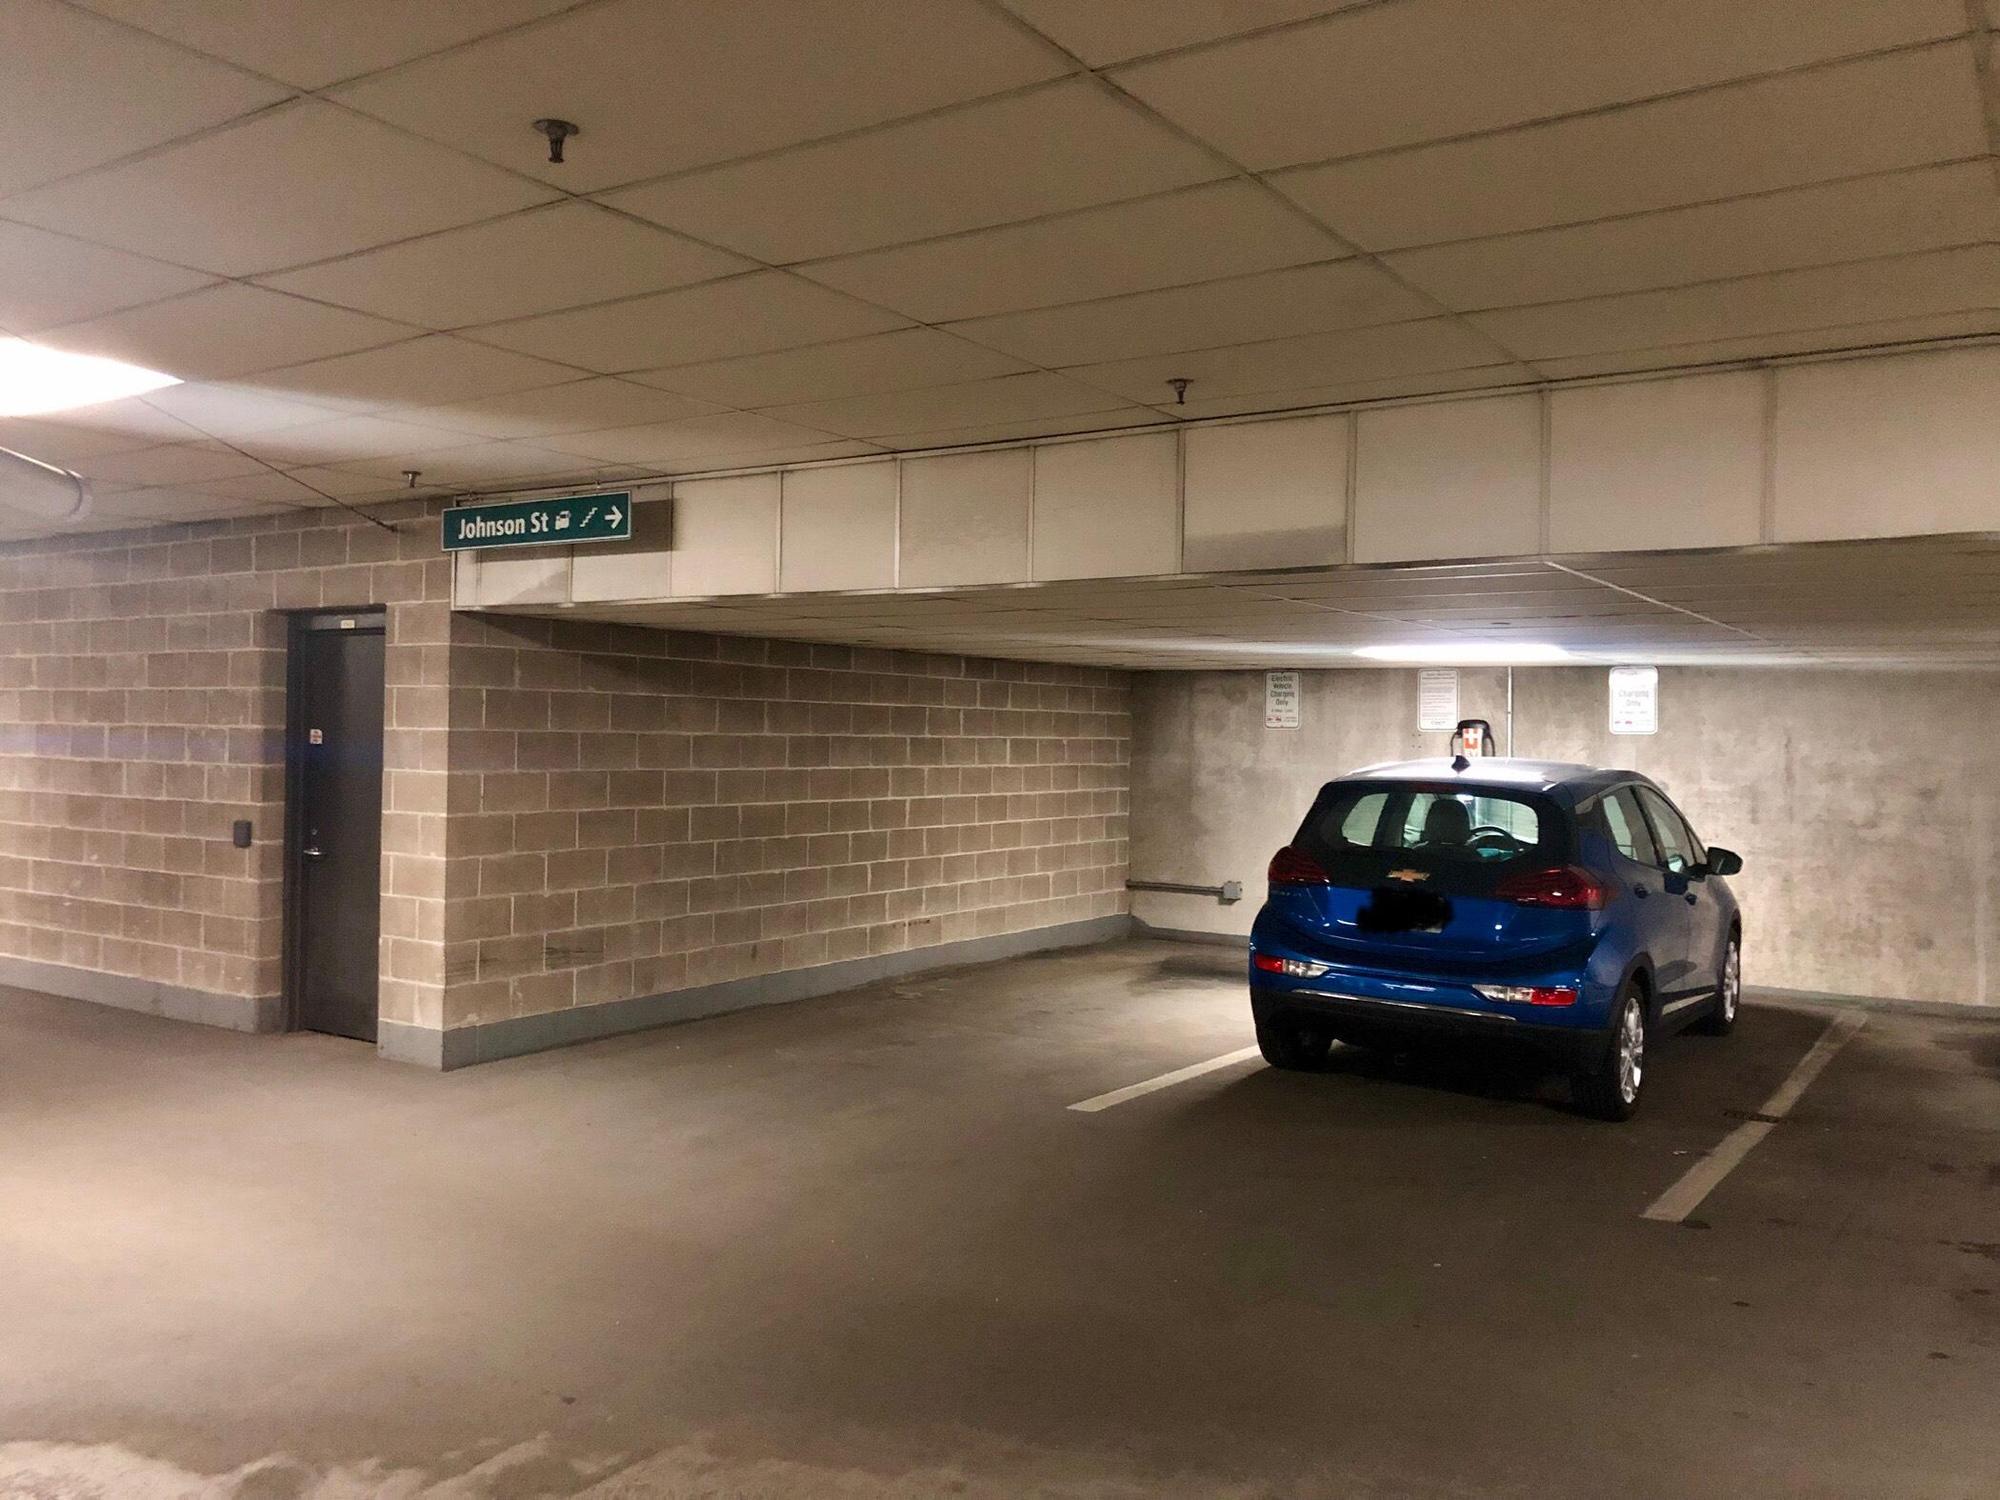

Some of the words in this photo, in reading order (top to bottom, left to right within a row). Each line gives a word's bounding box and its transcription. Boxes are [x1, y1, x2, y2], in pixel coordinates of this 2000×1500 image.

[458, 515, 525, 540] Johnson
[530, 511, 549, 534] St
[1270, 690, 1295, 698] Charging
[1275, 699, 1288, 707] Only
